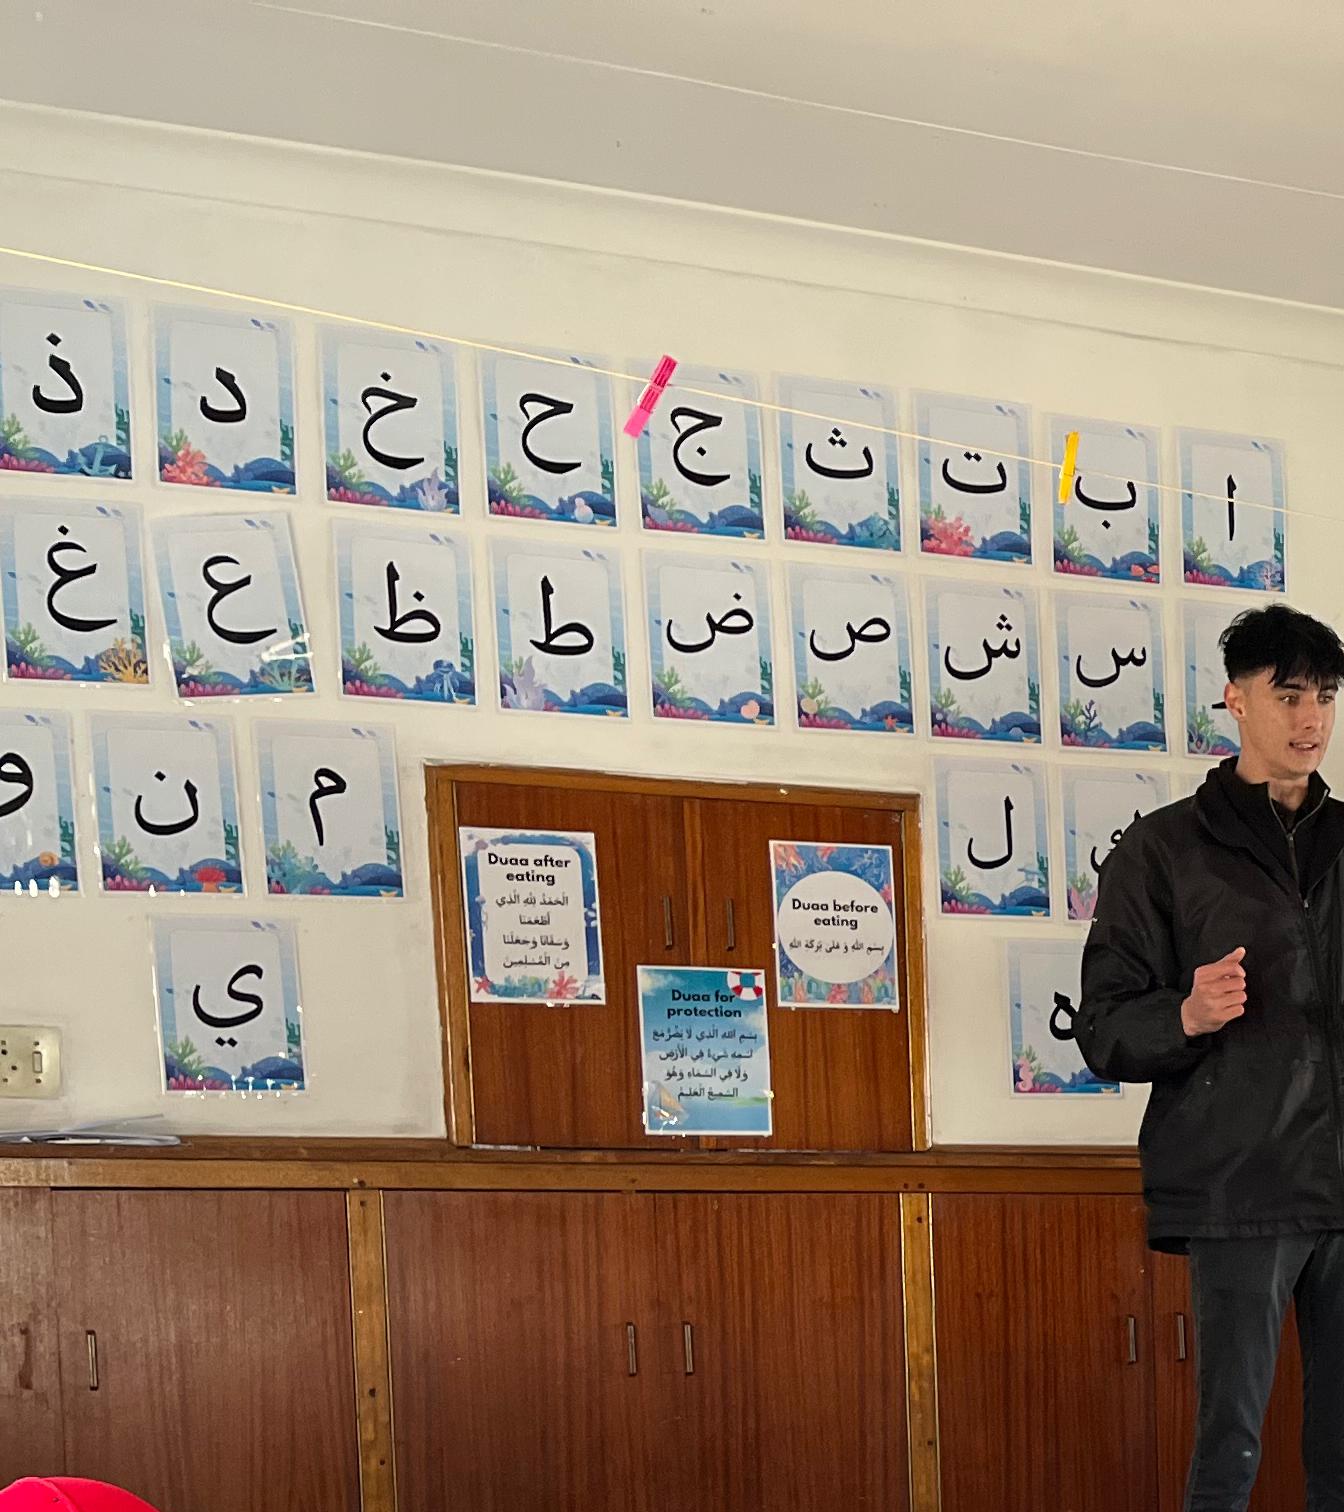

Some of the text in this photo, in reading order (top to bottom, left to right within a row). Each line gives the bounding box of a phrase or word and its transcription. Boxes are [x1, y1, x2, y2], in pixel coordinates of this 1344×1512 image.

[32, 333, 83, 414] ذ
[200, 367, 247, 423] د
[361, 372, 425, 470] خ
[519, 393, 582, 475] ح
[670, 407, 731, 487] ج
[805, 427, 874, 479] ث
[942, 451, 1007, 494] ت
[1074, 476, 1137, 529] ب
[1227, 474, 1237, 541] ا
[47, 525, 118, 633] غ
[202, 555, 277, 645] ع
[373, 561, 441, 644] ظ
[529, 575, 594, 656] ط
[666, 593, 754, 653] ض
[809, 617, 891, 662] ص
[944, 614, 1021, 681] ش
[1076, 647, 1147, 688] س
[134, 771, 199, 836] ن
[309, 767, 347, 846] م
[967, 795, 1014, 870] ل
[488, 853, 571, 867] Duaa after
[506, 870, 555, 886] eating
[792, 898, 878, 913] Duaa before
[814, 915, 858, 930] eating
[192, 964, 264, 1048] ي
[667, 1005, 741, 1019] protection
[672, 989, 735, 1003] Duaa for
